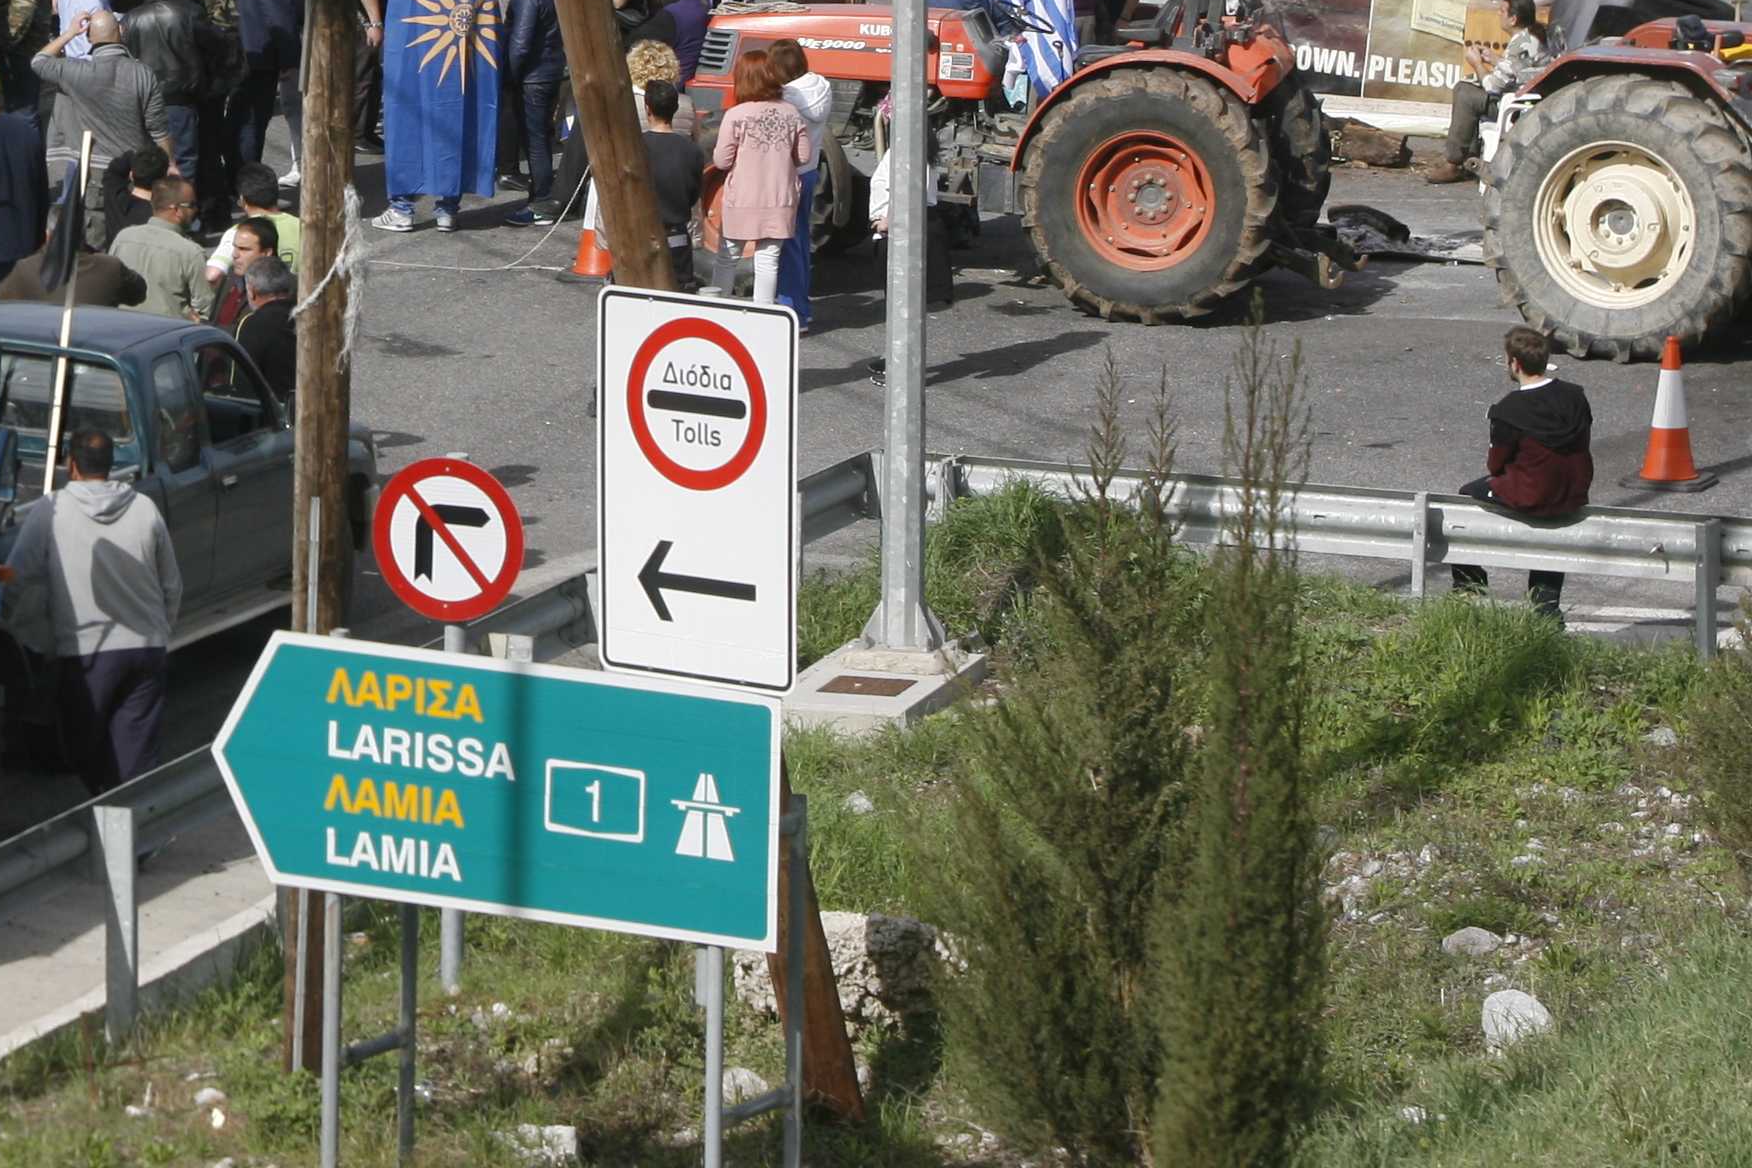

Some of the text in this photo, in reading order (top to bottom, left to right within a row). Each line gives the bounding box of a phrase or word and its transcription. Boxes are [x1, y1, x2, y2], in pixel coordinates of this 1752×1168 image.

[859, 23, 892, 36] KUB
[1367, 54, 1461, 90] PLEASU
[662, 361, 732, 391] Διόδια
[671, 418, 722, 447] Tolls
[326, 667, 484, 723] ΛΑΡΙΣΑ
[327, 720, 516, 781] LARISSA
[324, 774, 465, 829] ΛΑΜΙΑ
[585, 779, 600, 823] 1
[326, 826, 463, 882] LAMIA
